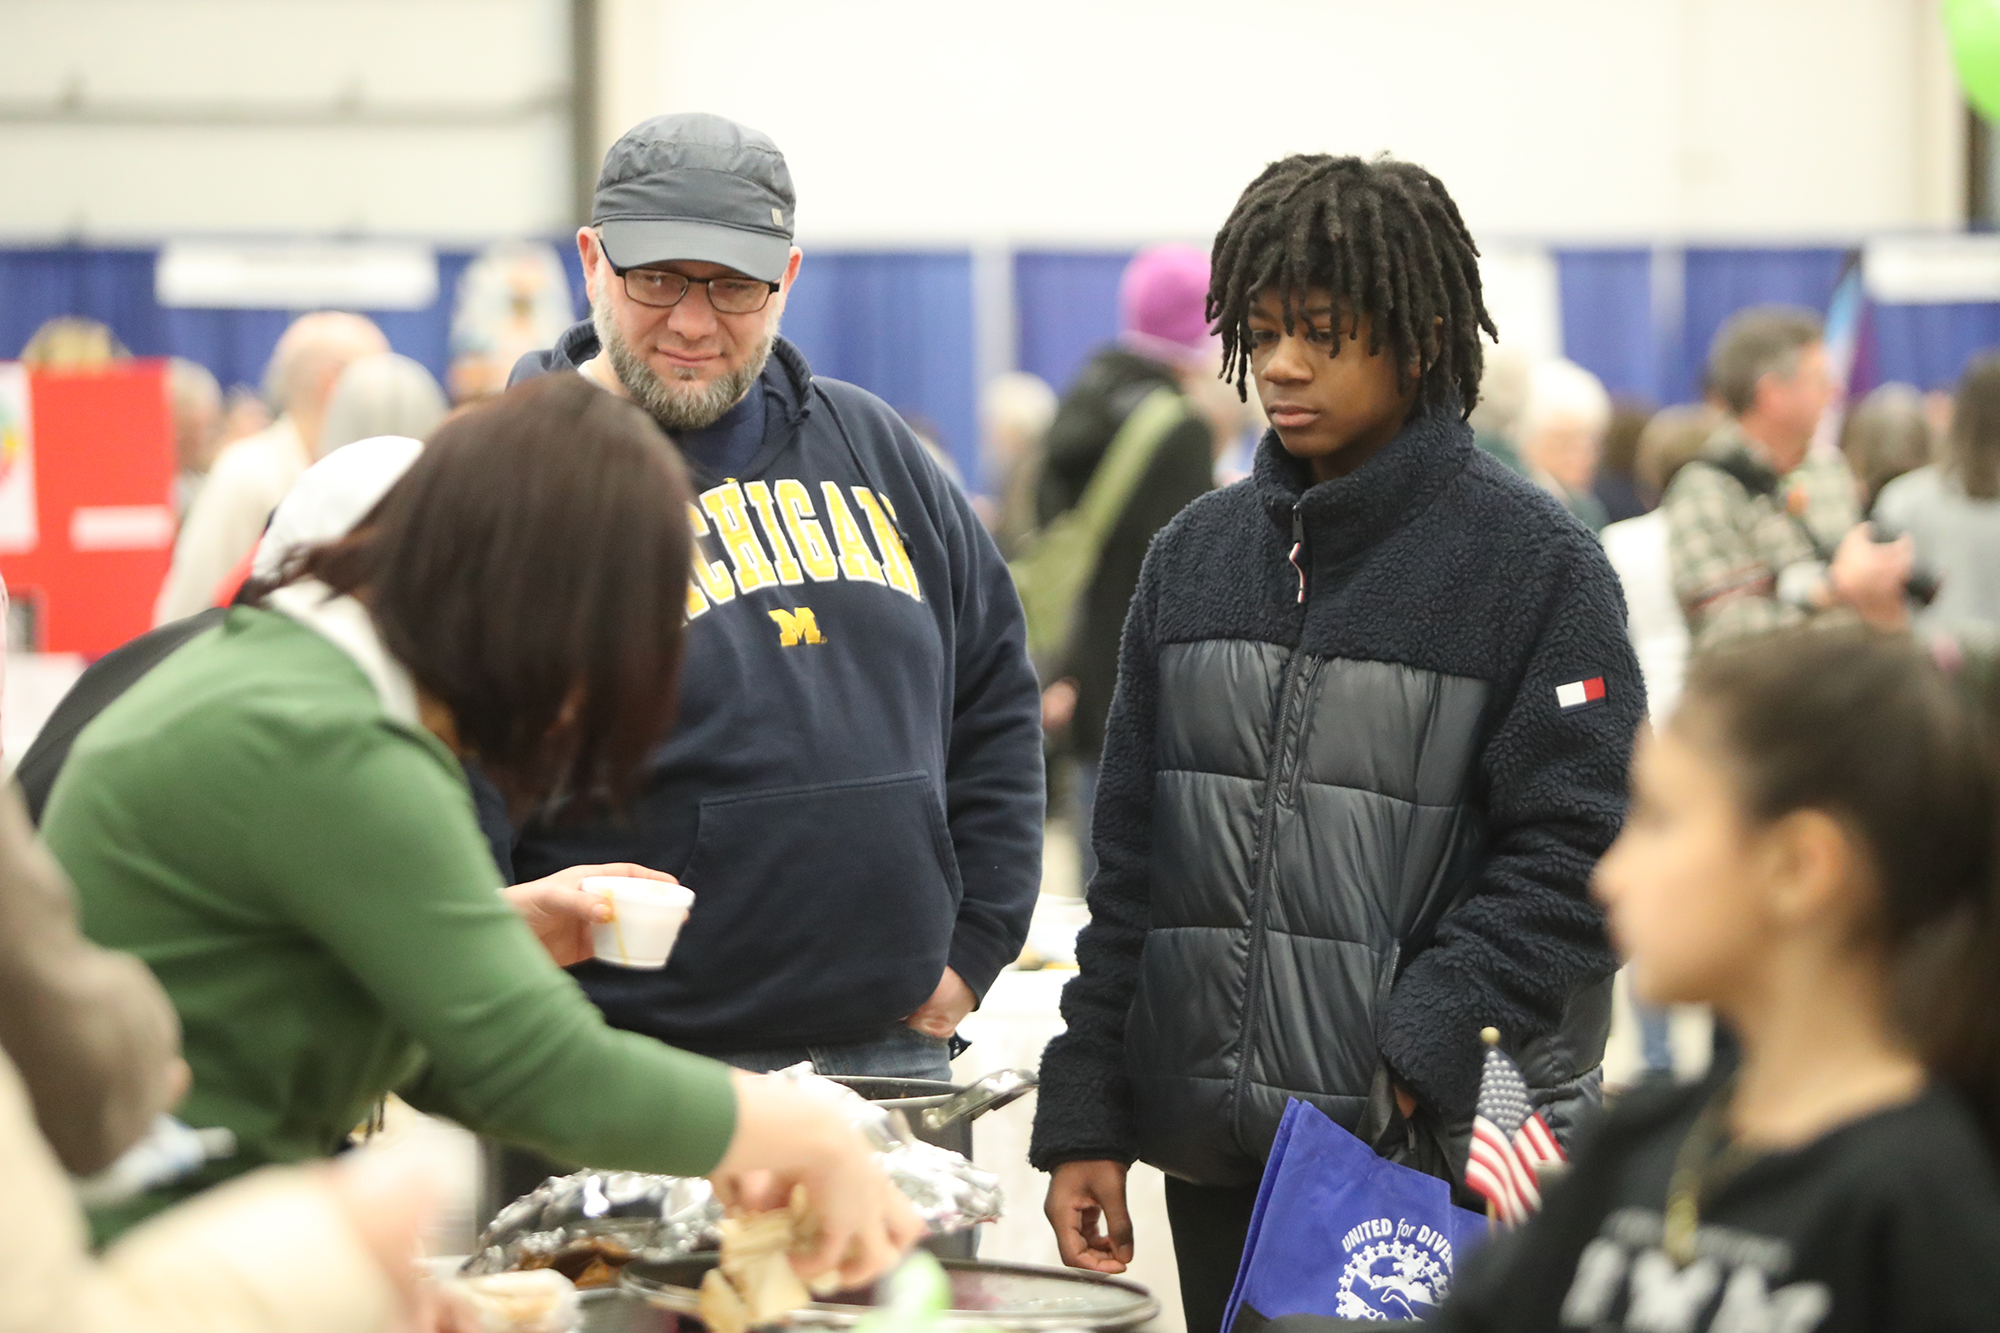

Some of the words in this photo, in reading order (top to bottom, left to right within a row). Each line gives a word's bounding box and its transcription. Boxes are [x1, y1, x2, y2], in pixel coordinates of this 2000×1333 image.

[768, 606, 821, 647] M
[1341, 1217, 1393, 1253] UNITED
[1393, 1217, 1417, 1241] for
